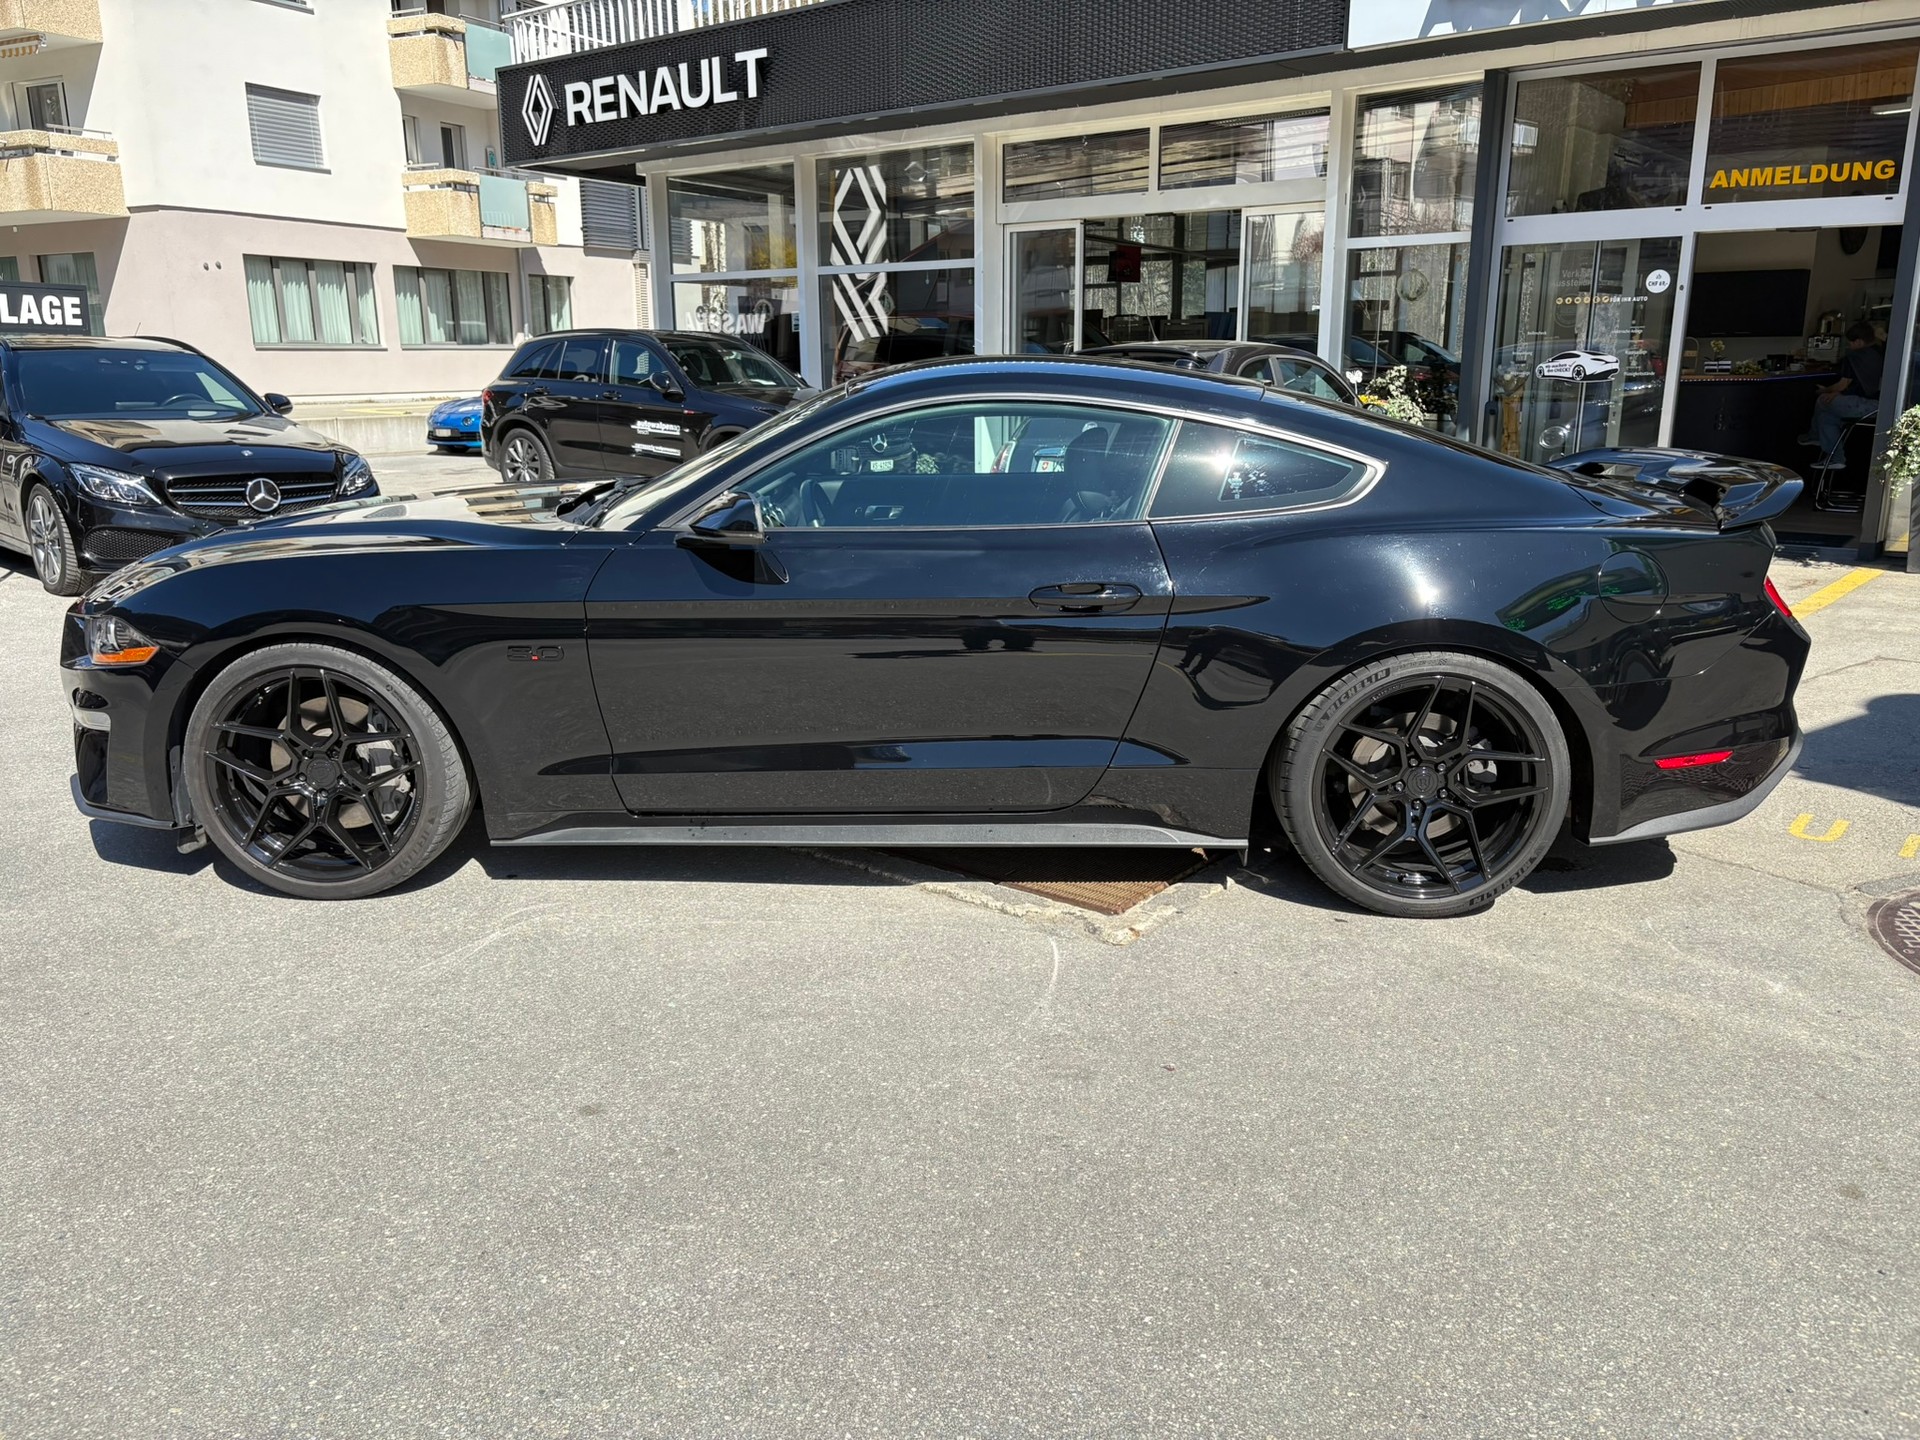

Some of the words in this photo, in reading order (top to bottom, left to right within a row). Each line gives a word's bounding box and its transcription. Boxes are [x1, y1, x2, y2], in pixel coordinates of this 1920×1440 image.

[563, 48, 768, 127] RENAULT
[1709, 159, 1896, 190] ANMELDUNG
[0, 293, 83, 326] LAGE
[1609, 295, 1620, 303] FÜR
[1326, 667, 1391, 717] MICHELIN
[1468, 856, 1538, 906] MICHELIN
